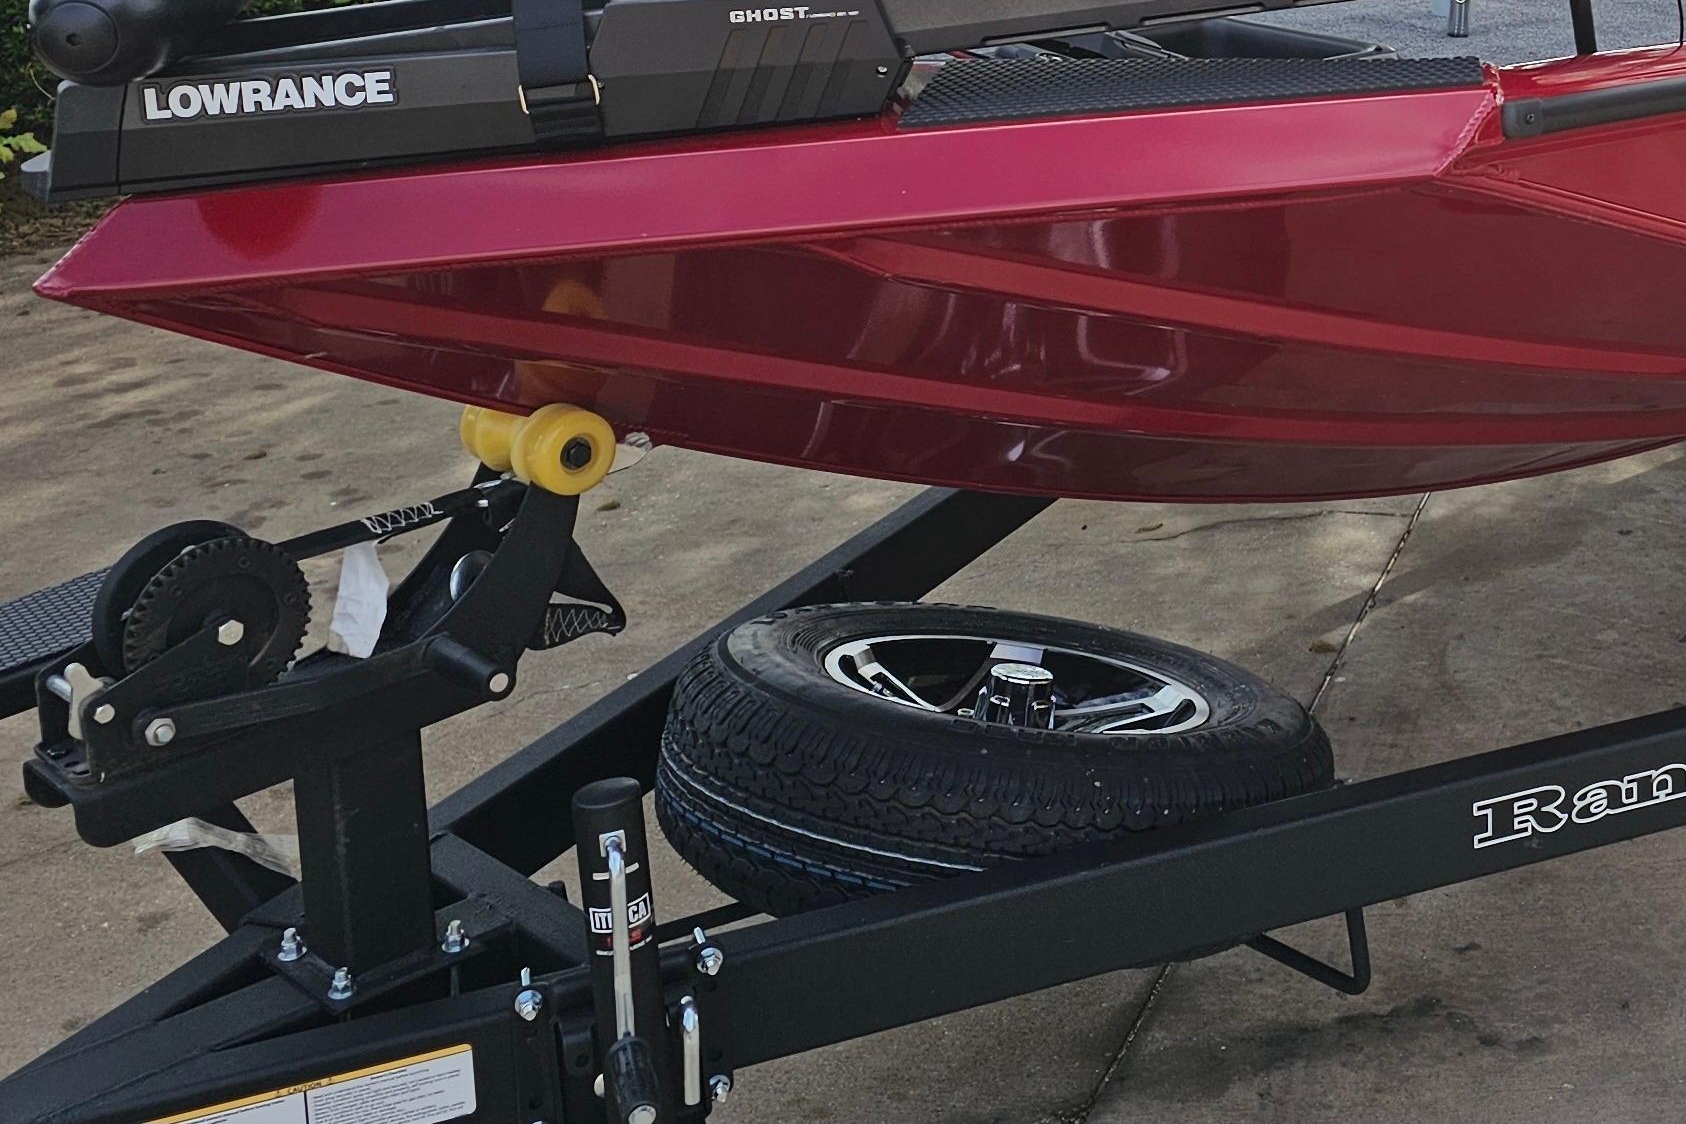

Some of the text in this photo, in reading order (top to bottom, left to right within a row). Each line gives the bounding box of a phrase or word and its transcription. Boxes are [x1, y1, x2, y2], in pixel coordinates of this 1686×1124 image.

[729, 7, 809, 23] GHOST
[144, 71, 394, 120] LOWRANCE
[594, 900, 647, 929] ITCA
[287, 1080, 322, 1094] CAUTION
